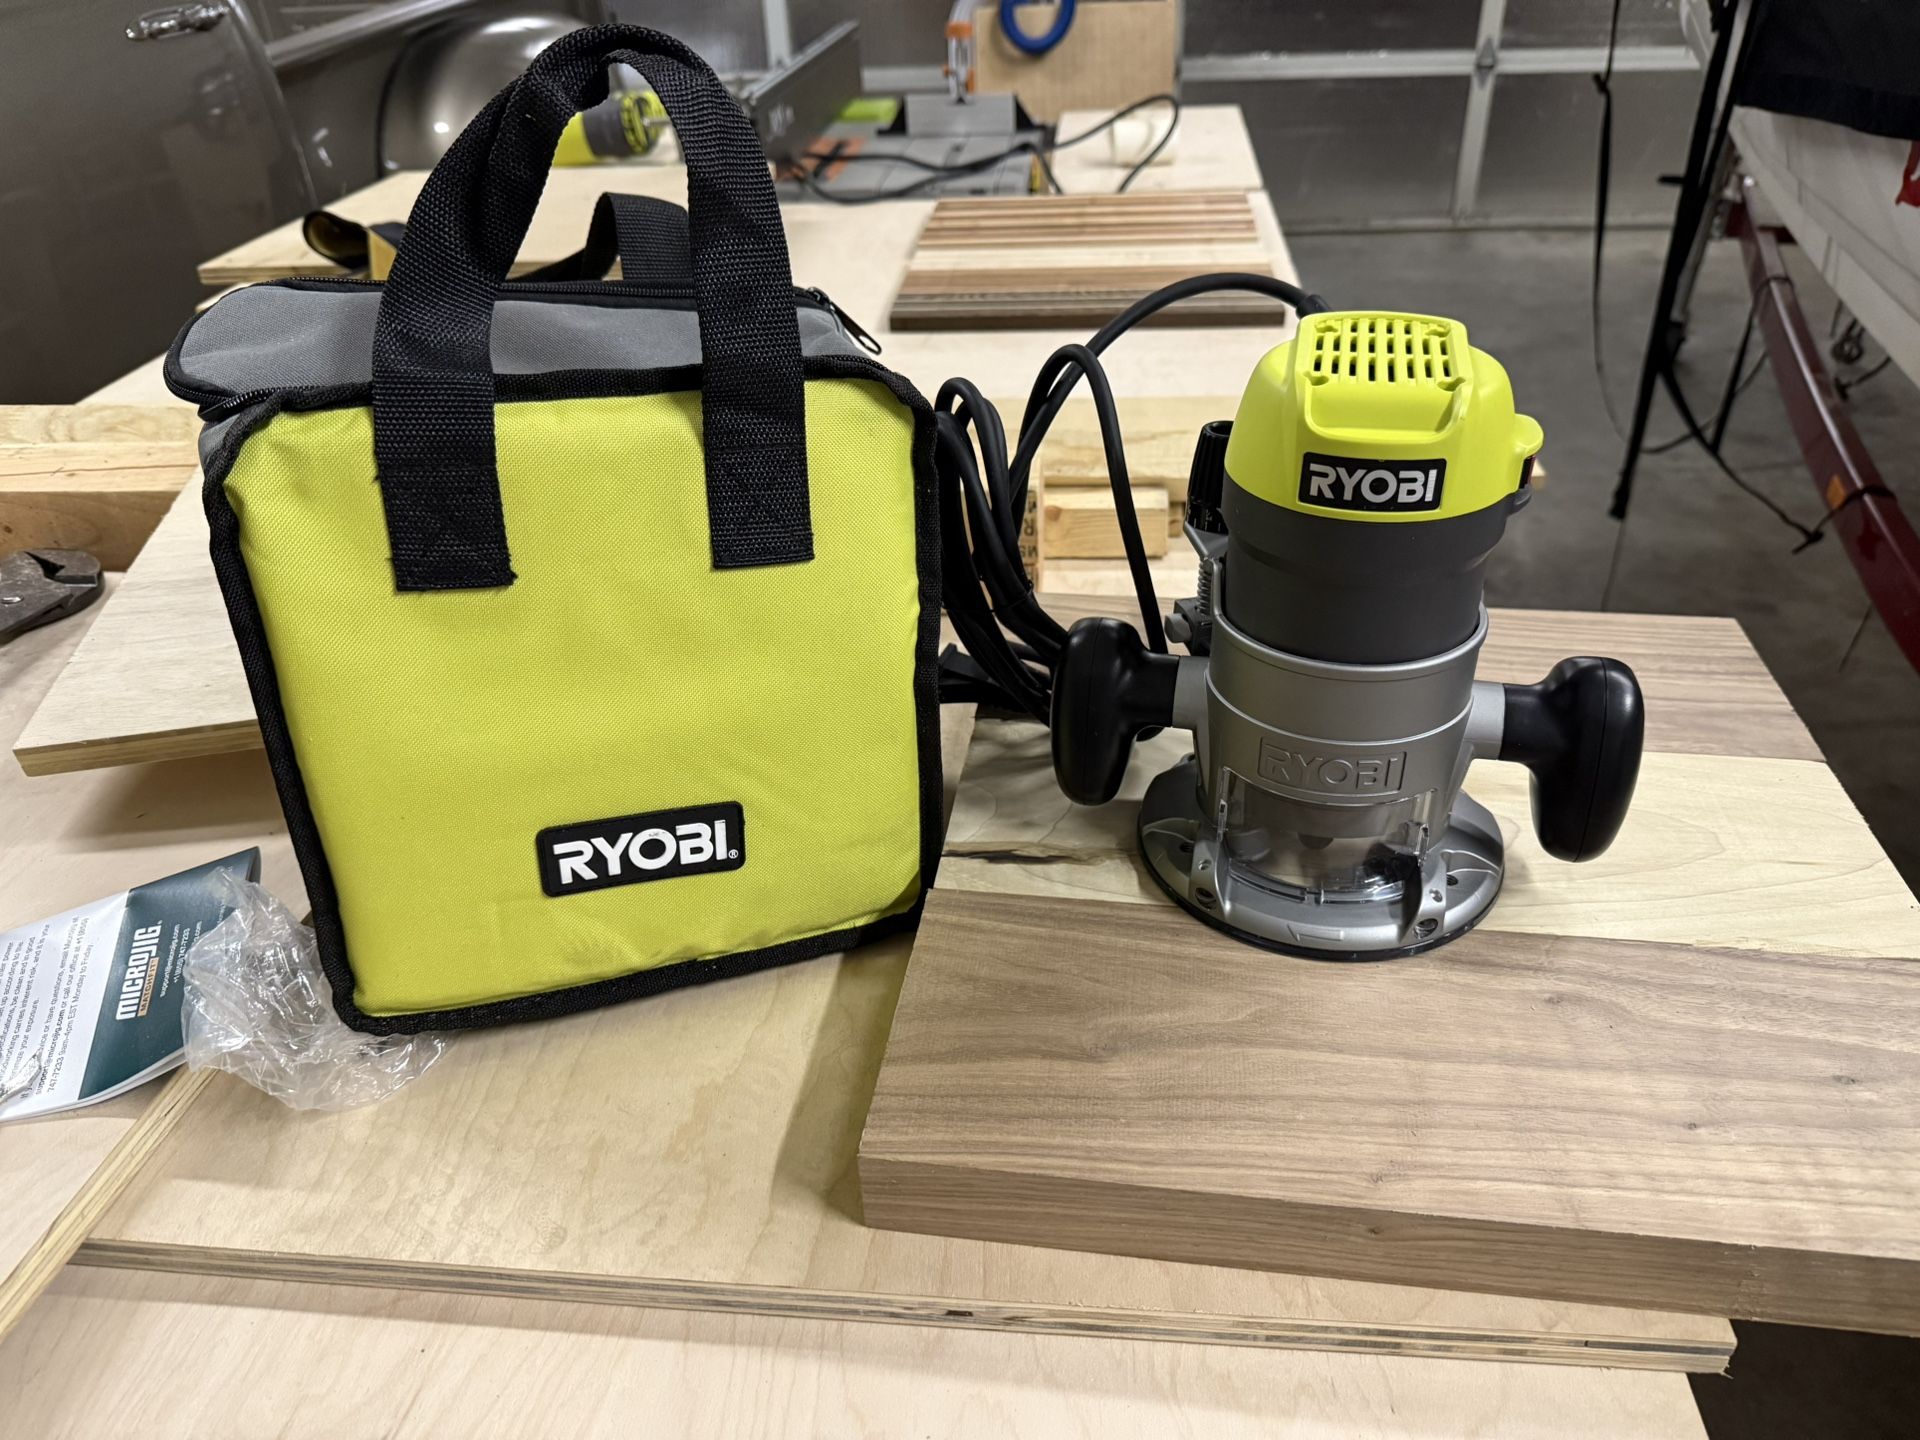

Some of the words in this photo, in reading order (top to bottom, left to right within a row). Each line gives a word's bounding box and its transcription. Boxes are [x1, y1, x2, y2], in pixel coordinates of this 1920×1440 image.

[1309, 463, 1438, 504] RYOBI
[1262, 743, 1399, 790] RYOBI
[67, 1005, 78, 1019] EST
